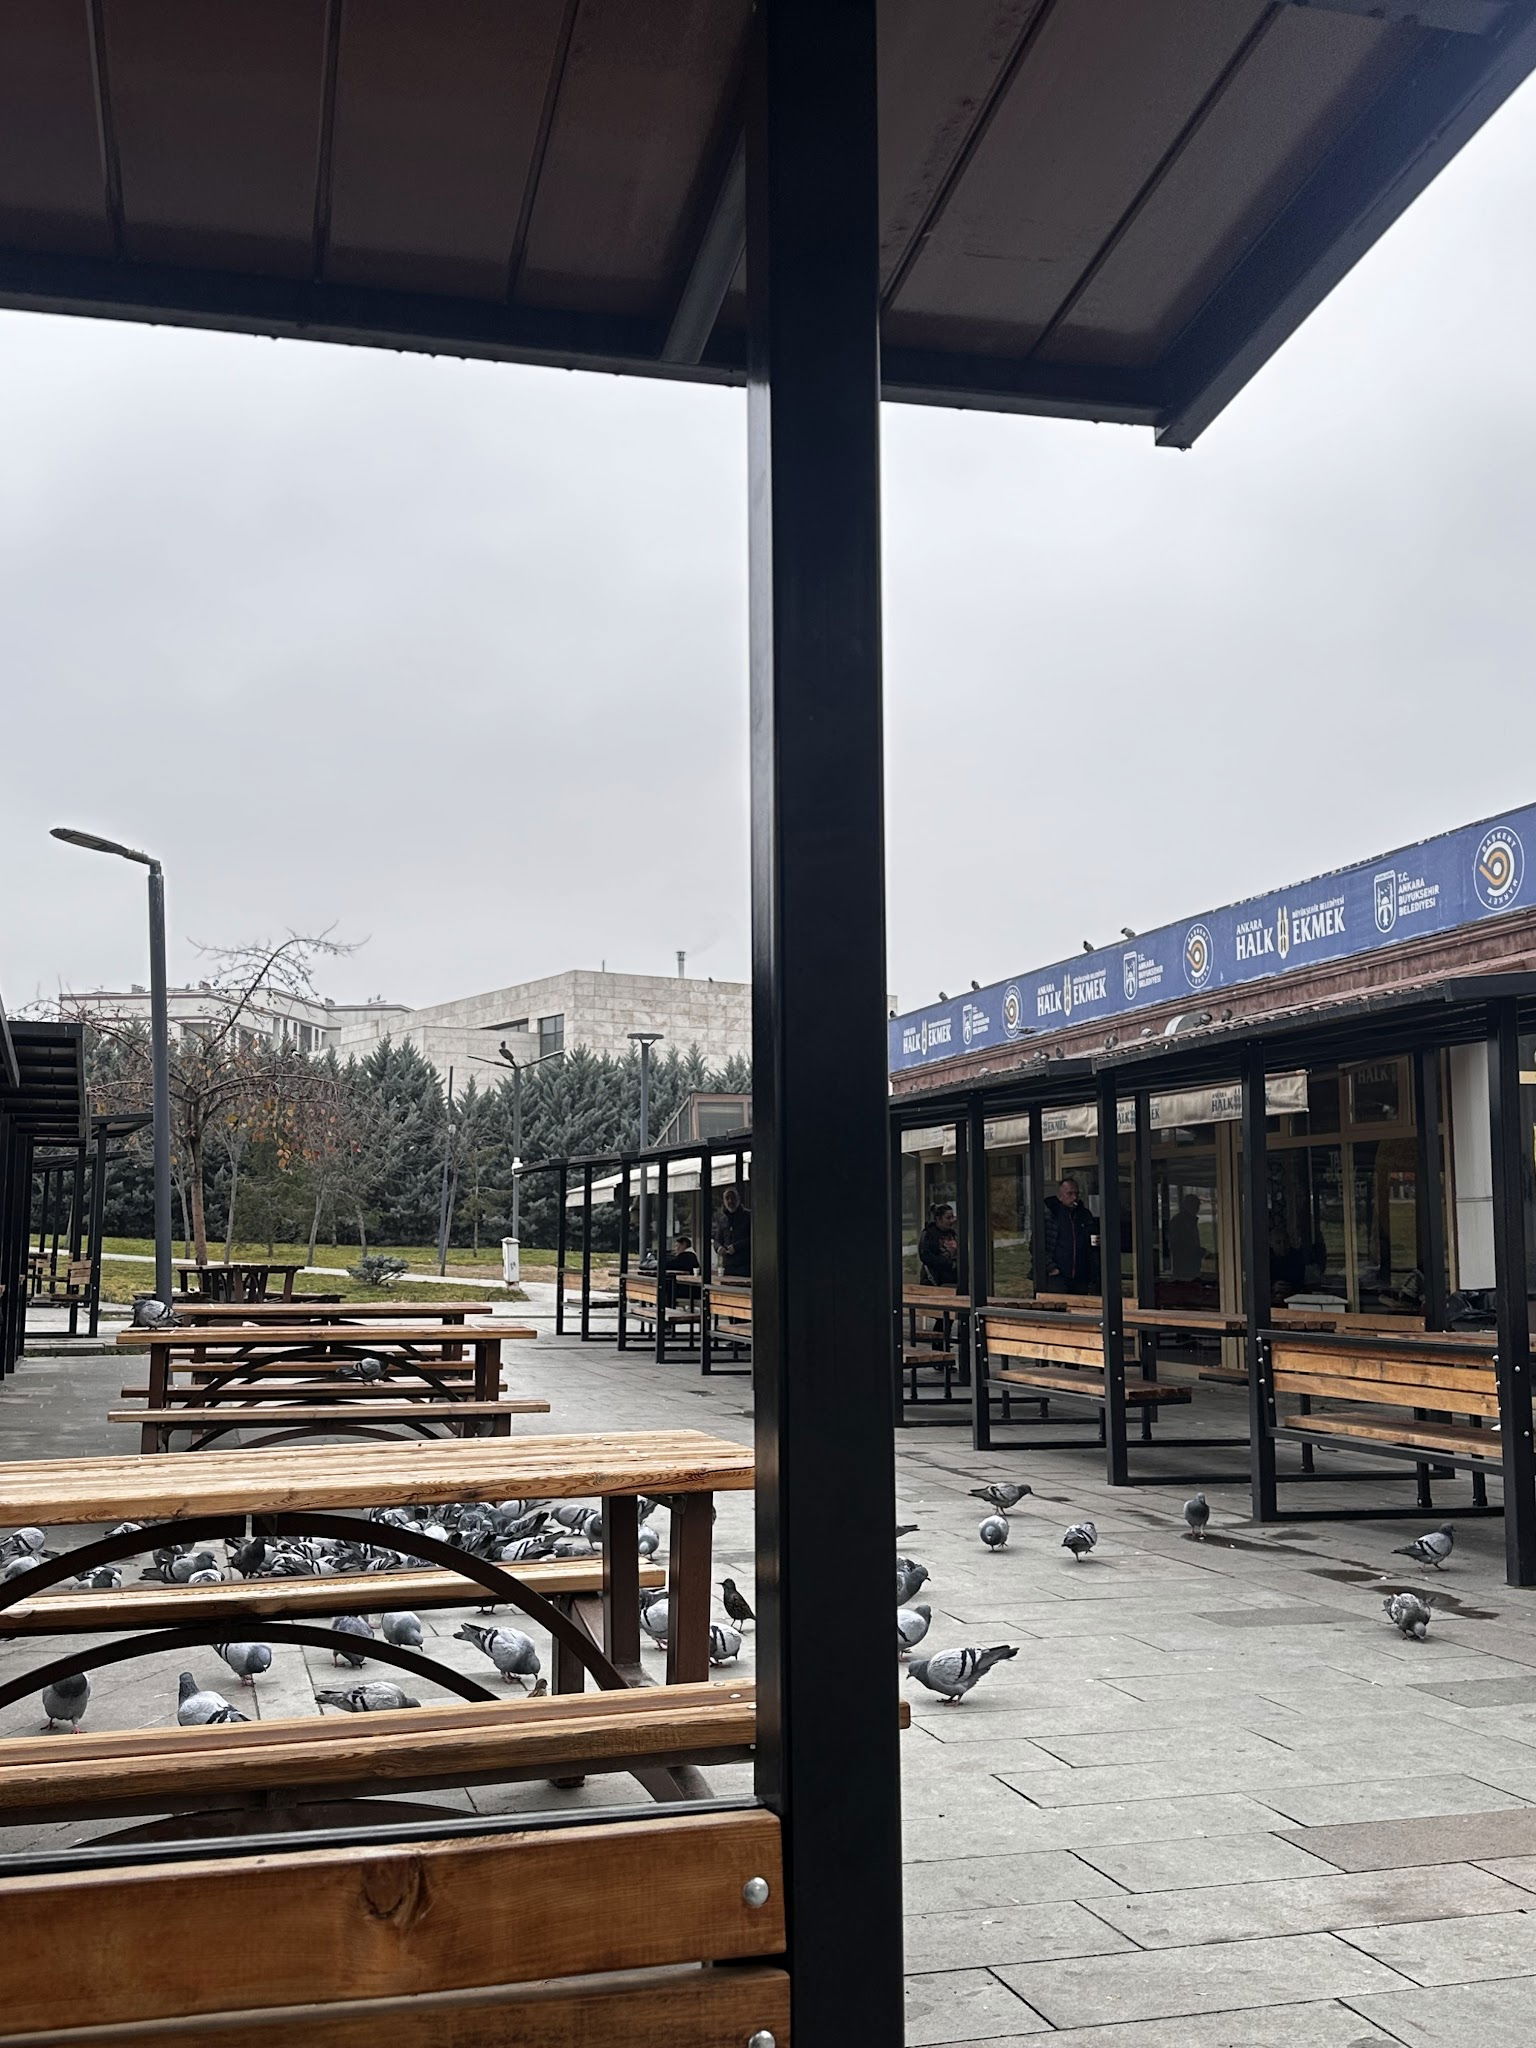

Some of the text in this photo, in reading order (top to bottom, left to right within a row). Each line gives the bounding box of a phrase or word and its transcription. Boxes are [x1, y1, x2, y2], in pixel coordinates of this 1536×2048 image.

[1398, 877, 1426, 894] ANKARA
[1236, 918, 1263, 936] ANKARA
[1236, 906, 1346, 961] HALK EKMEK
[1036, 977, 1107, 1017] HALK EKMEK
[903, 1033, 921, 1055] HALK
[928, 1024, 952, 1047] EKMEK
[1211, 1096, 1234, 1113] HALK
